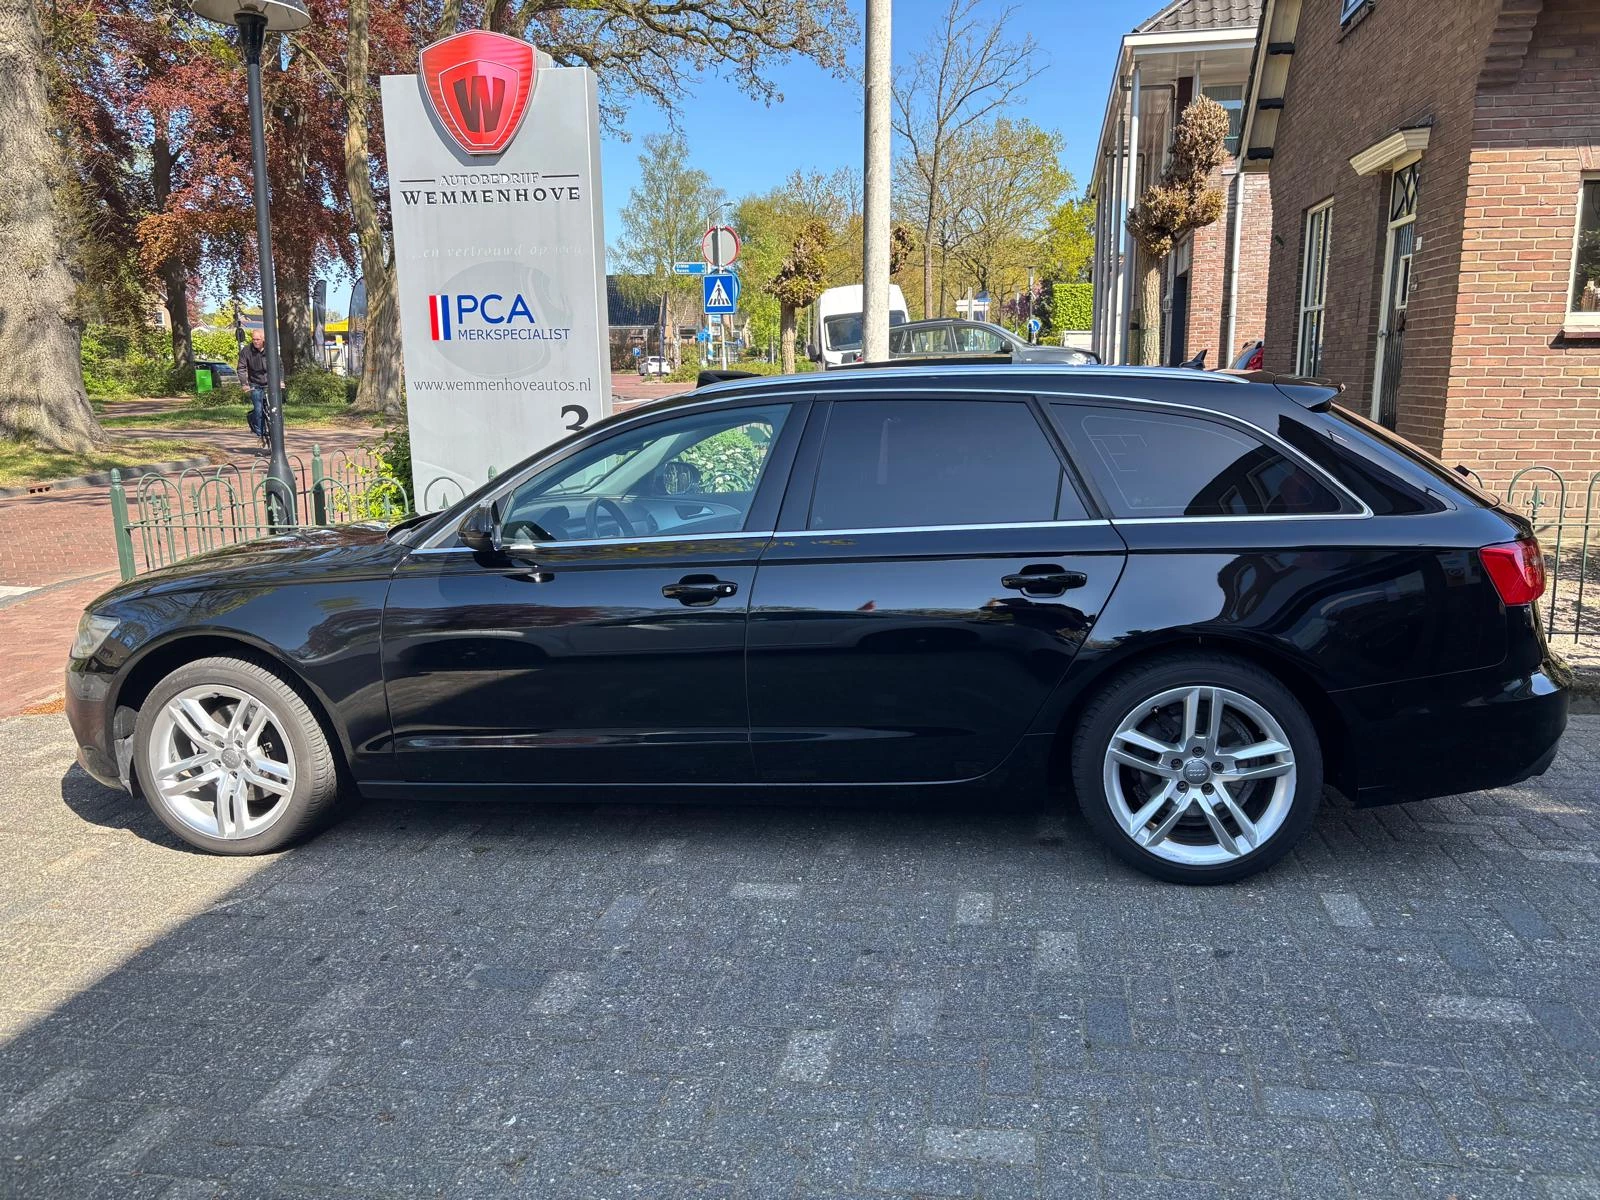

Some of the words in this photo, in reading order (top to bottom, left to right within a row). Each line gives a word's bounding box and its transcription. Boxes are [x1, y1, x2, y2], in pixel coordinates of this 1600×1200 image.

[453, 75, 506, 133] W
[439, 172, 540, 186] AUTOBEDRIJF
[401, 187, 581, 206] WEMMENHOVE
[457, 294, 535, 324] PCA
[458, 328, 571, 341] MERKSPECIALIST
[413, 377, 592, 392] www.wemmenhoveautos.nl
